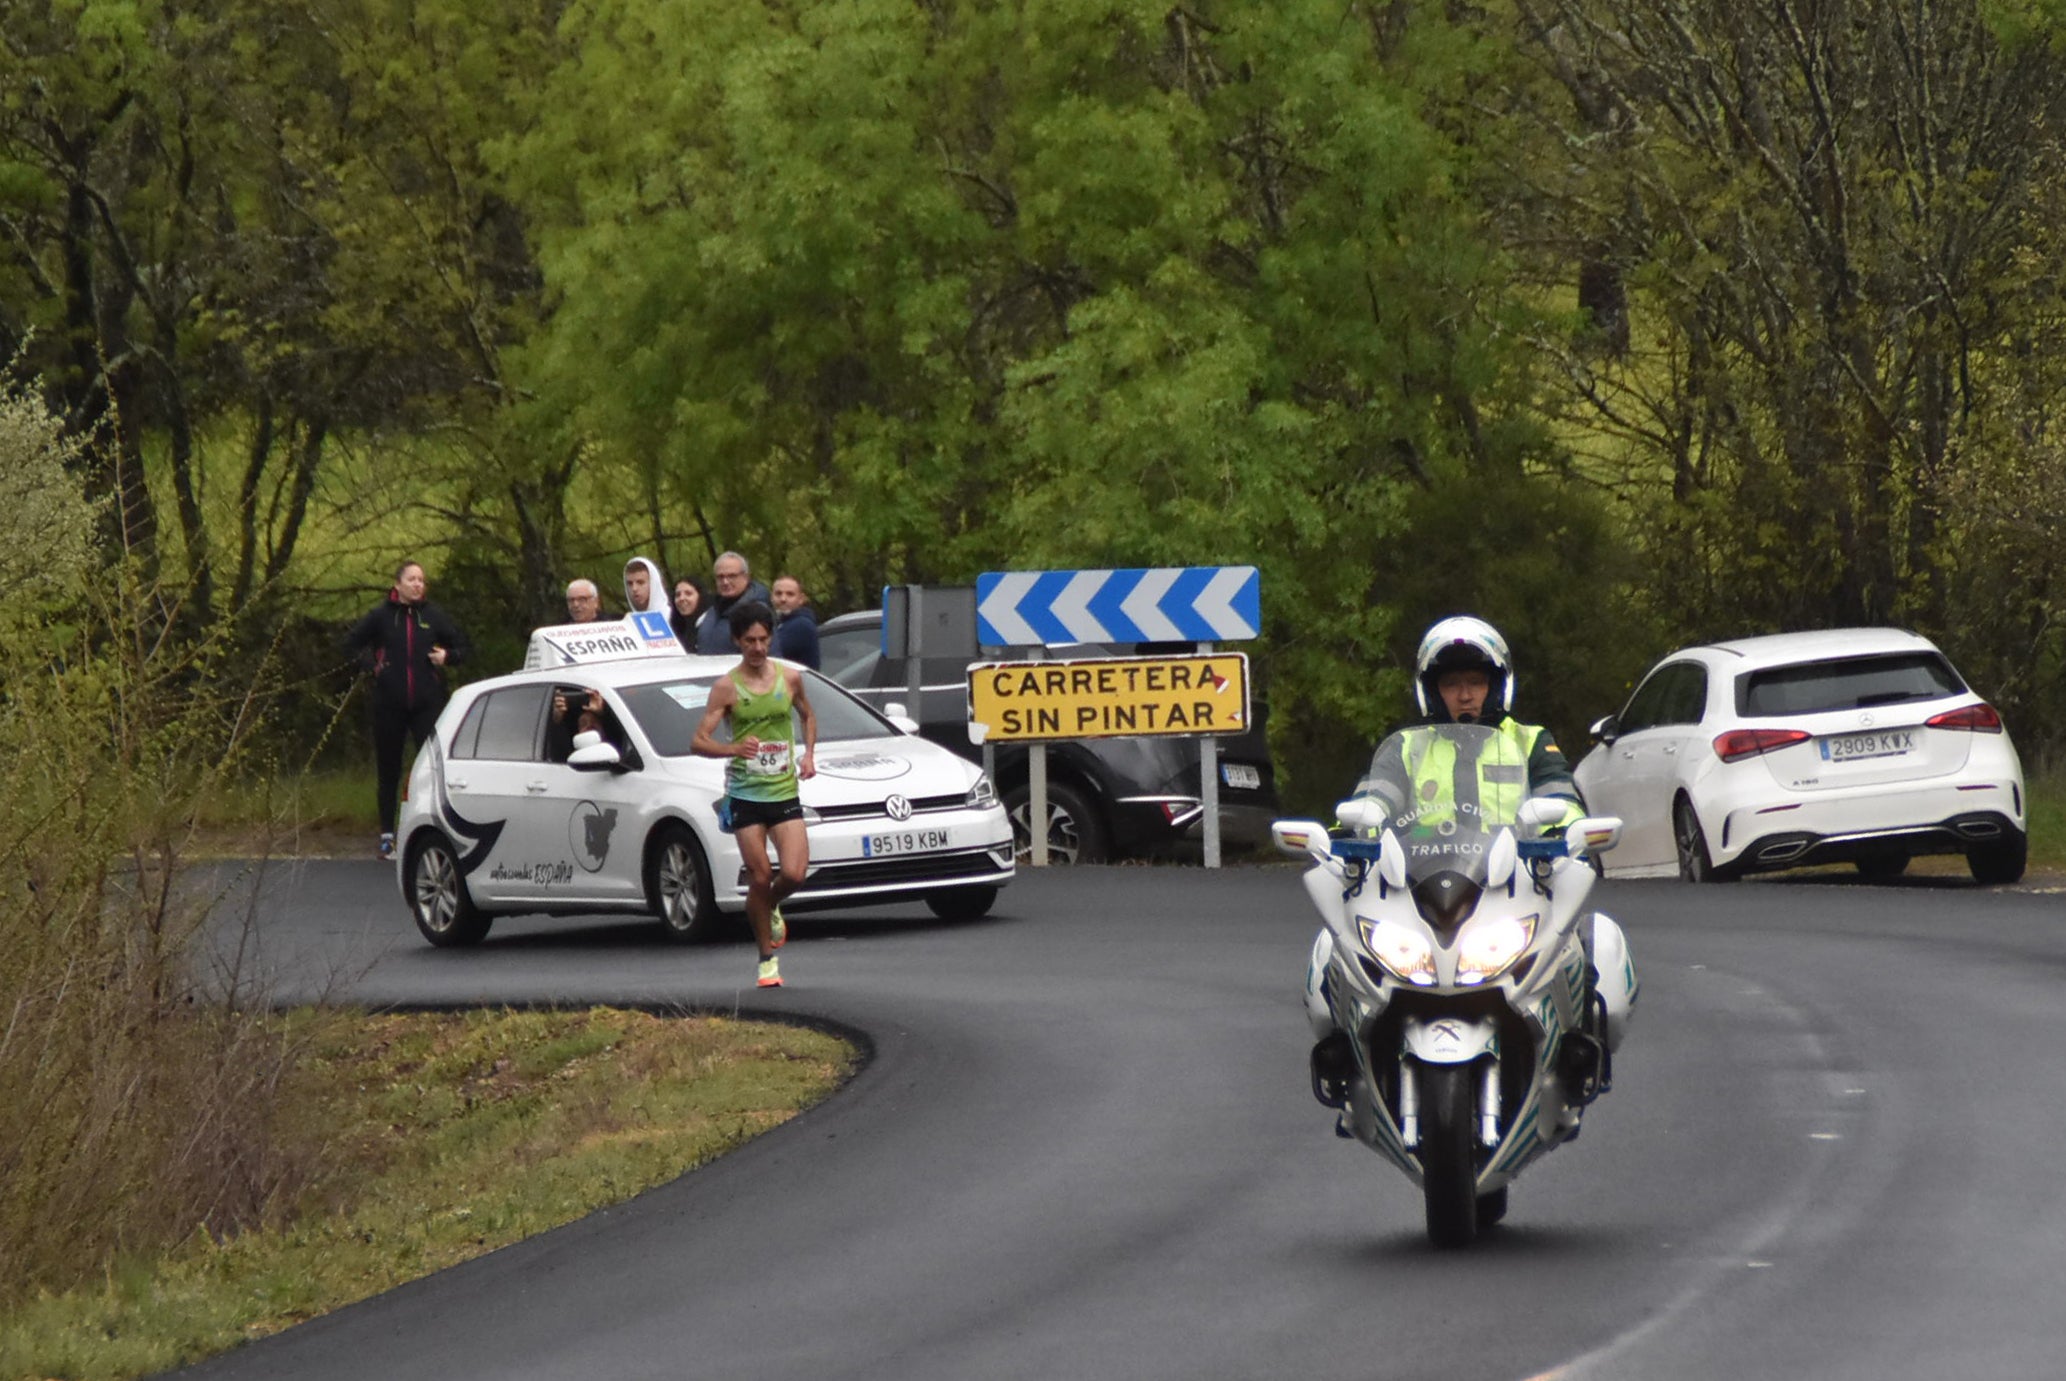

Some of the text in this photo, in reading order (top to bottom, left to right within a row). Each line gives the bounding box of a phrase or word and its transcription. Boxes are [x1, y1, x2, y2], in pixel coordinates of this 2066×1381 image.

[640, 616, 665, 637] L
[566, 634, 638, 656] ESPAÑA
[993, 664, 1215, 697] CARRETERA
[1002, 702, 1214, 734] SIN PINTAR
[1832, 737, 1875, 756] 2909
[1881, 731, 1913, 750] KWX
[761, 754, 777, 766] 66
[873, 831, 948, 853] 9519 KBM
[1411, 843, 1483, 857] TRAFICO
